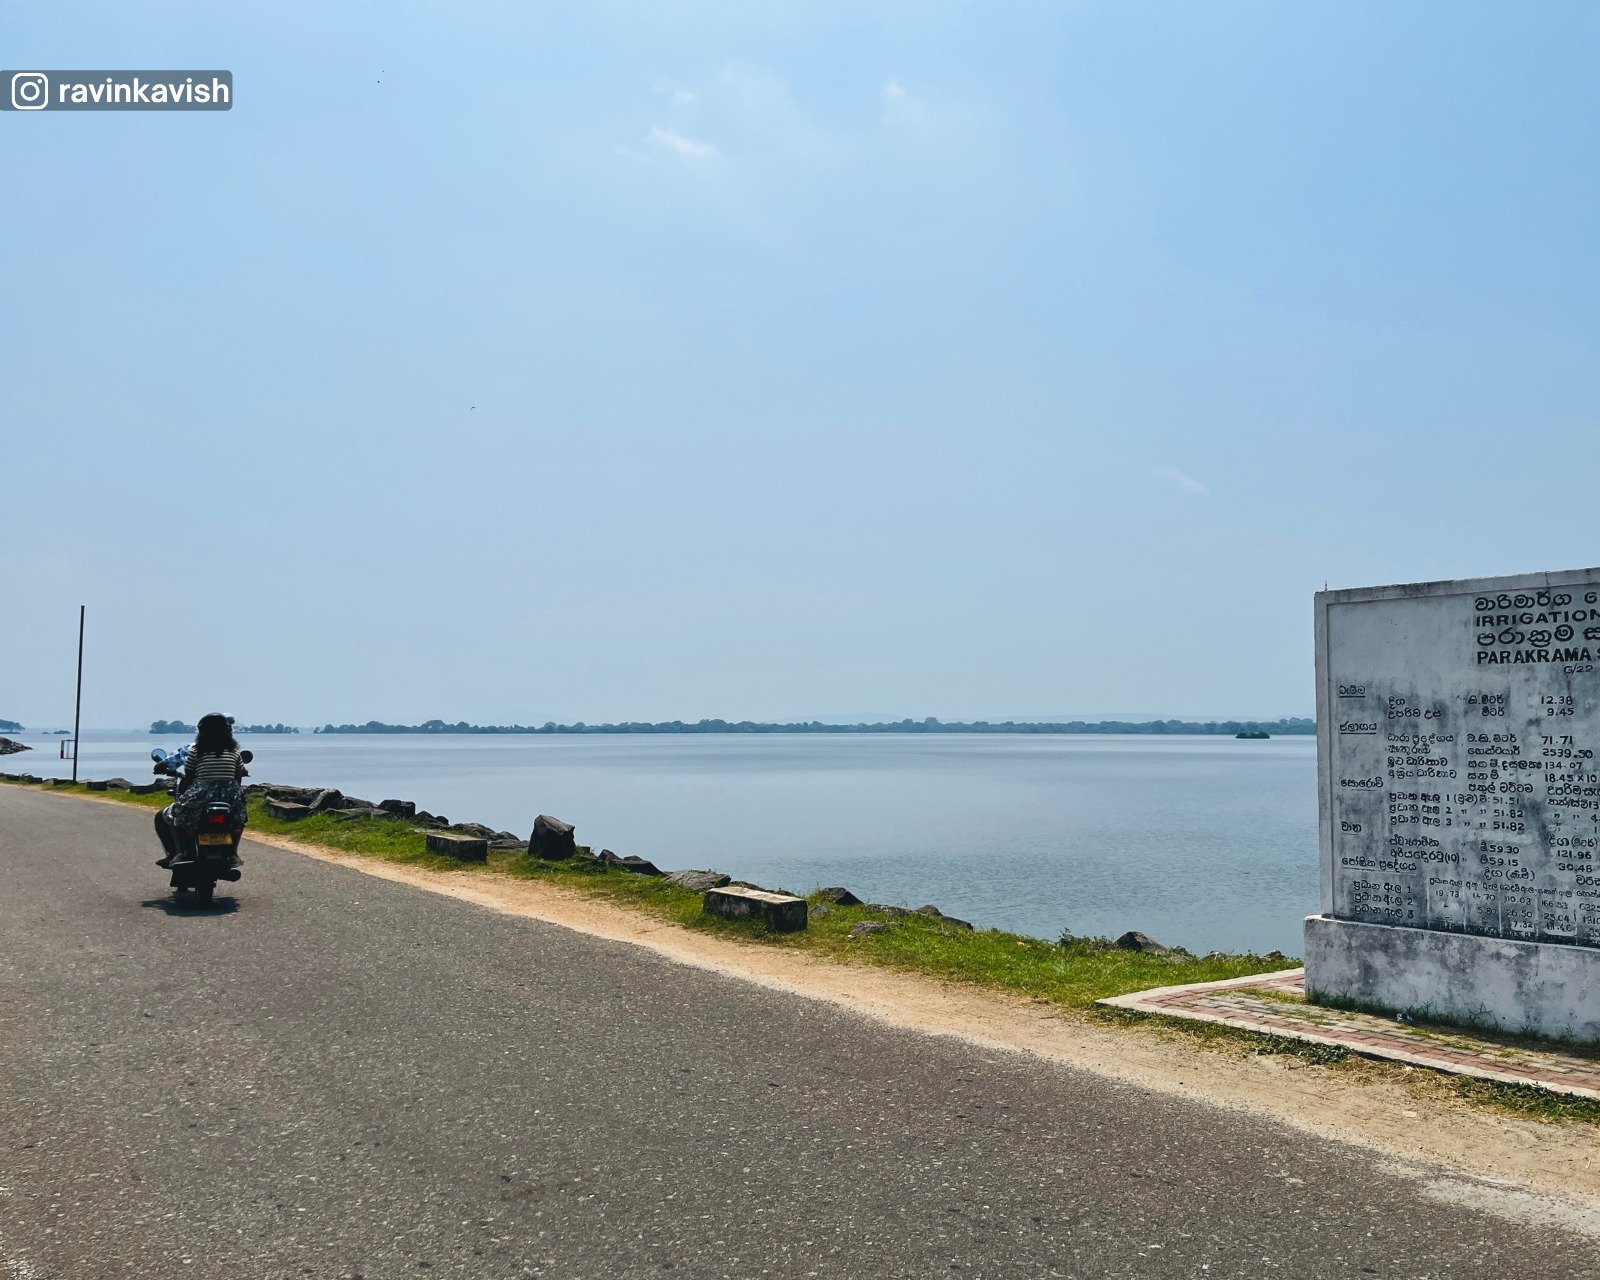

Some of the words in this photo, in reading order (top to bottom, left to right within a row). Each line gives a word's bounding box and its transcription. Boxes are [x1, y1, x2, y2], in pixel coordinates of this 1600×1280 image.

[1475, 590, 1573, 612] වාරිමාර්ග
[1476, 608, 1600, 627] IRRIGATION
[1476, 624, 1575, 648] පරාක්‍රම
[1477, 647, 1592, 665] PARAKRAMA
[1541, 695, 1573, 706] 12.38
[1547, 707, 1575, 717] 9.45
[1541, 735, 1573, 745] 71.71
[1542, 748, 1593, 759] 2539.50
[1545, 761, 1583, 770] 134.07
[1494, 809, 1524, 818] 51.82
[1493, 821, 1525, 832] 51.82
